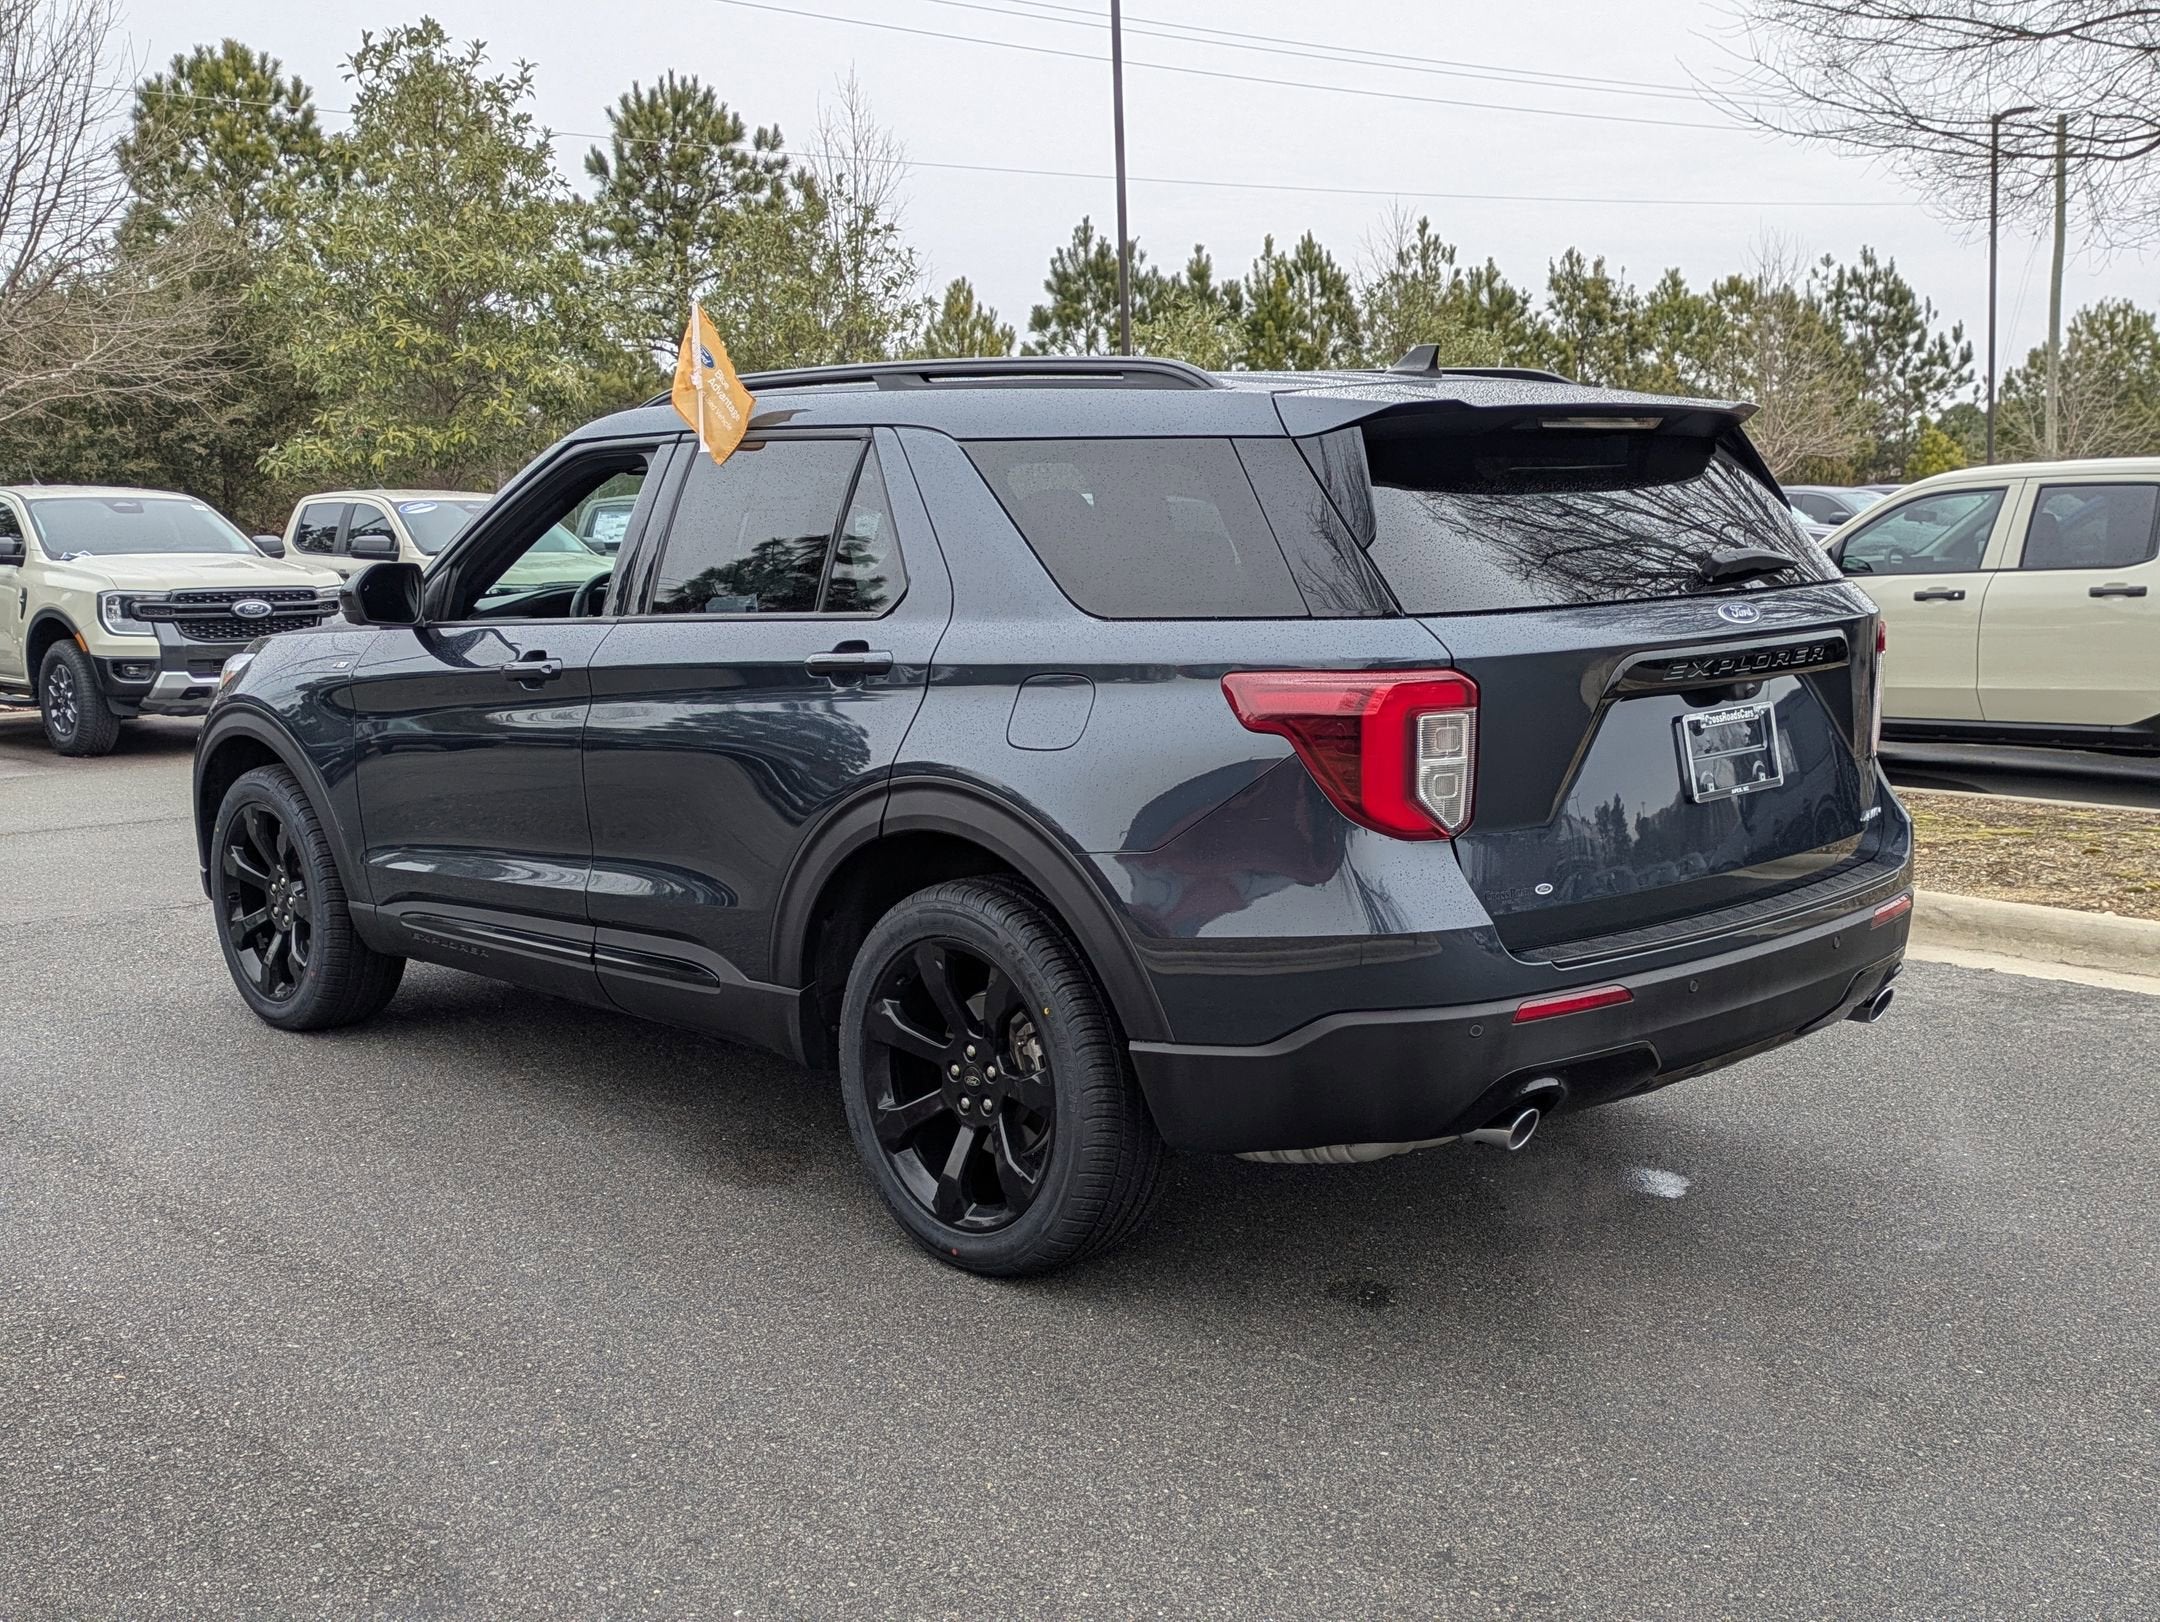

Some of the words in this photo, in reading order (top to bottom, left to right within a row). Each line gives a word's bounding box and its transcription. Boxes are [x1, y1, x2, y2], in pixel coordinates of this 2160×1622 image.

[707, 377, 741, 422] Advantage
[1730, 604, 1754, 618] Ford
[1662, 646, 1825, 681] EXPLORER
